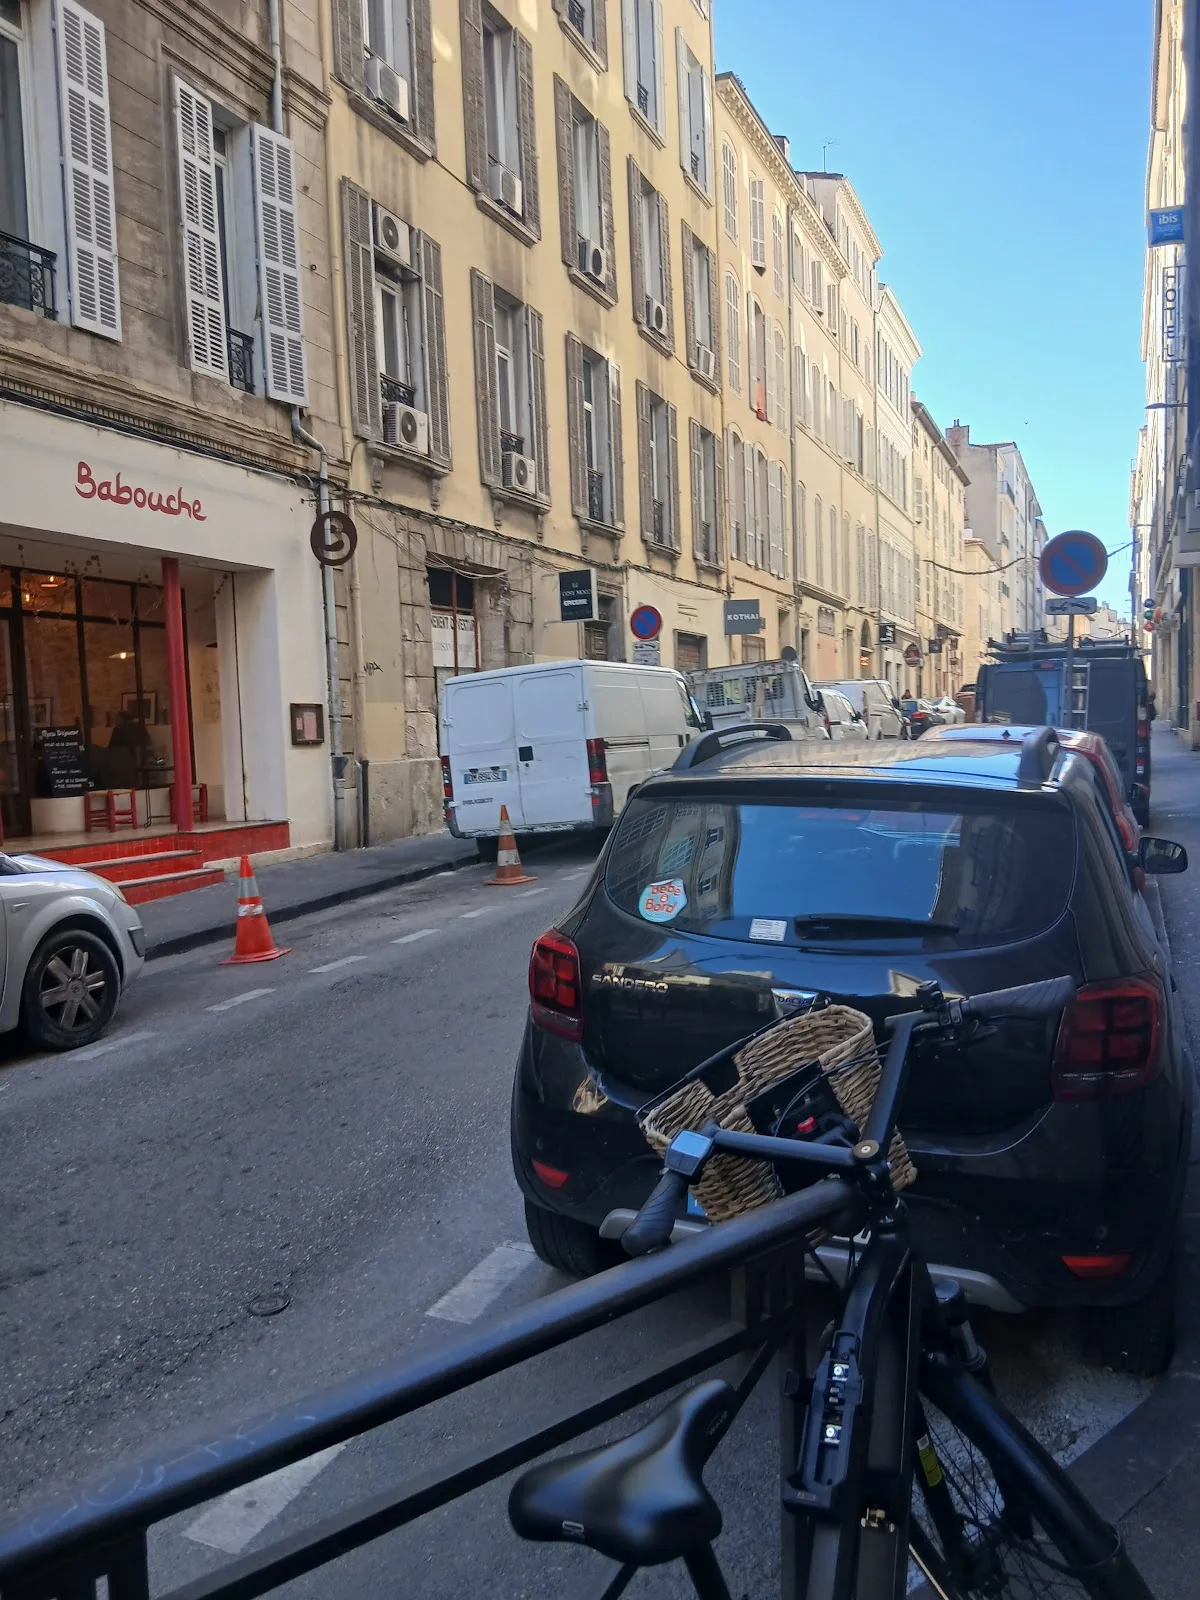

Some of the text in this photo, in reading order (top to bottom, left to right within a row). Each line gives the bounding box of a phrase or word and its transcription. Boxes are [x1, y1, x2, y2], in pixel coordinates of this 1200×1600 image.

[1158, 213, 1178, 225] ibis
[75, 461, 207, 521] Babouche
[592, 974, 669, 993] SANDERO
